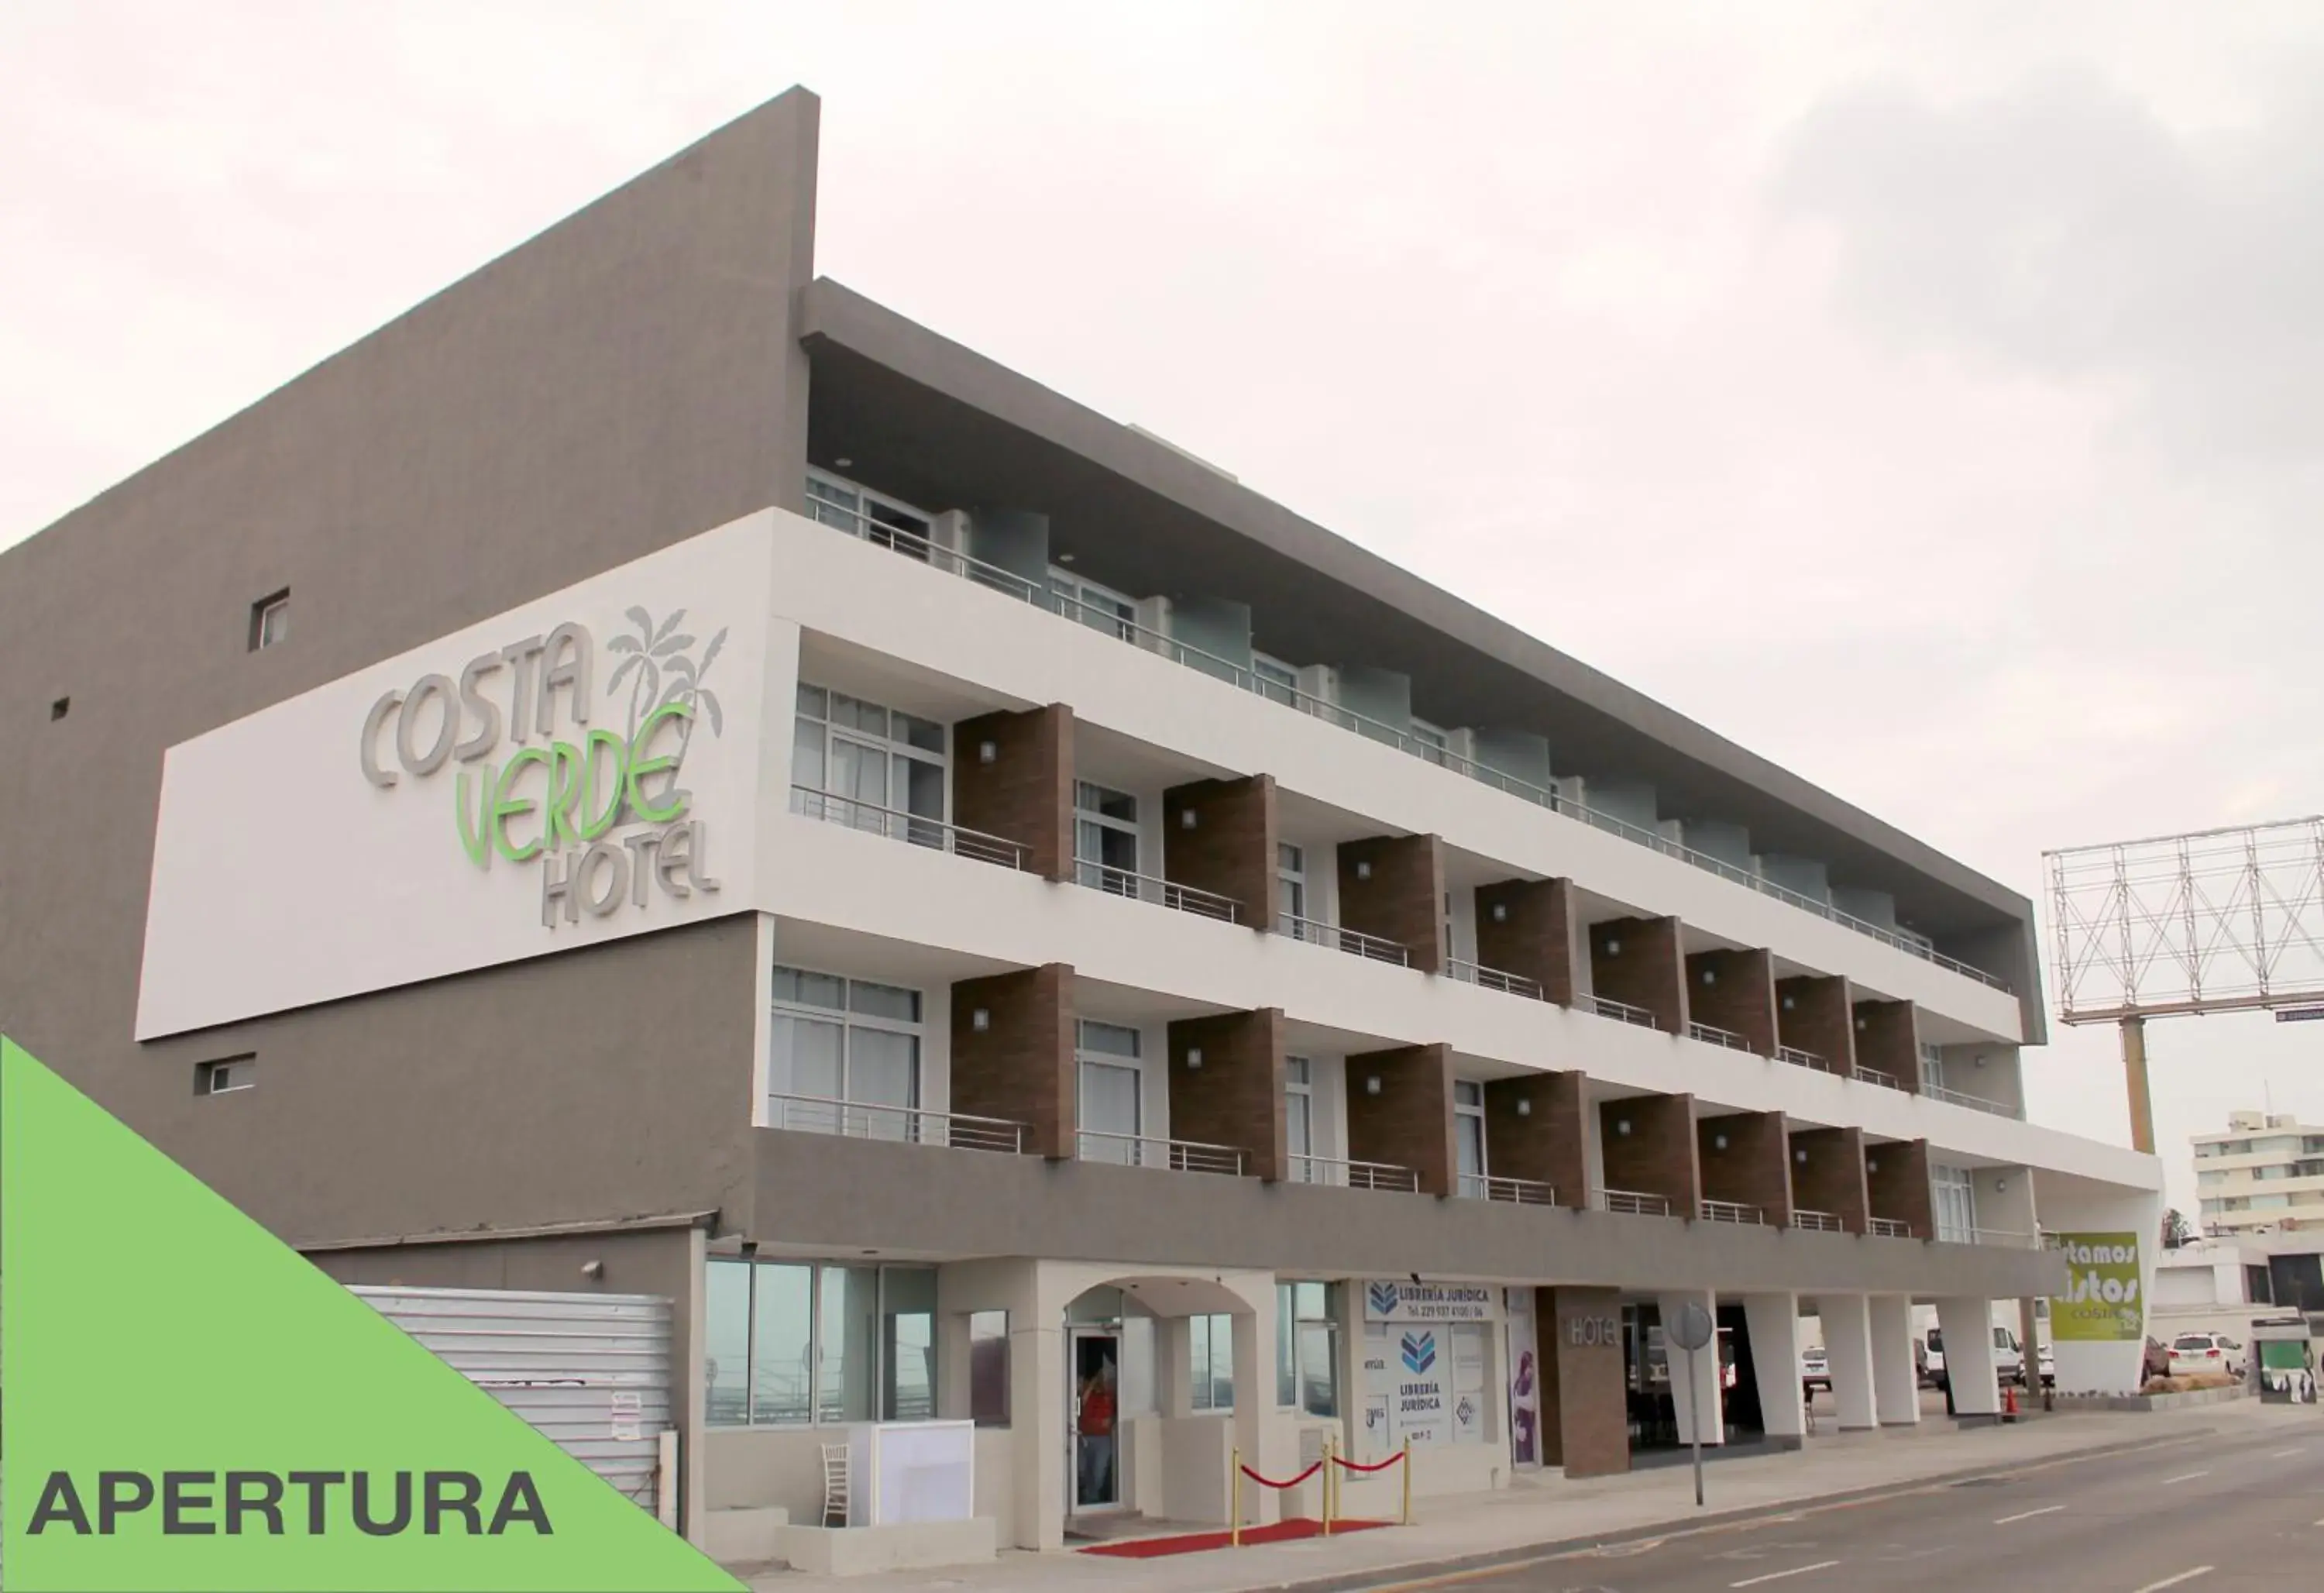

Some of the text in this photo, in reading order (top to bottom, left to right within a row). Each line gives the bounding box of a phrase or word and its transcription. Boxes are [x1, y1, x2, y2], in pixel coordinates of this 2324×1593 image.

[361, 621, 594, 790] COSTA
[455, 701, 696, 872] VERDE
[542, 820, 722, 930] HOTEL
[1399, 1284, 1489, 1302] LIBRERÍA JURÍDICA
[2054, 1268, 2138, 1304] istos
[1570, 1313, 1622, 1347] HOTEL
[1400, 1381, 1441, 1396] LIBRERÍA
[1400, 1395, 1441, 1412] JURÍDICA
